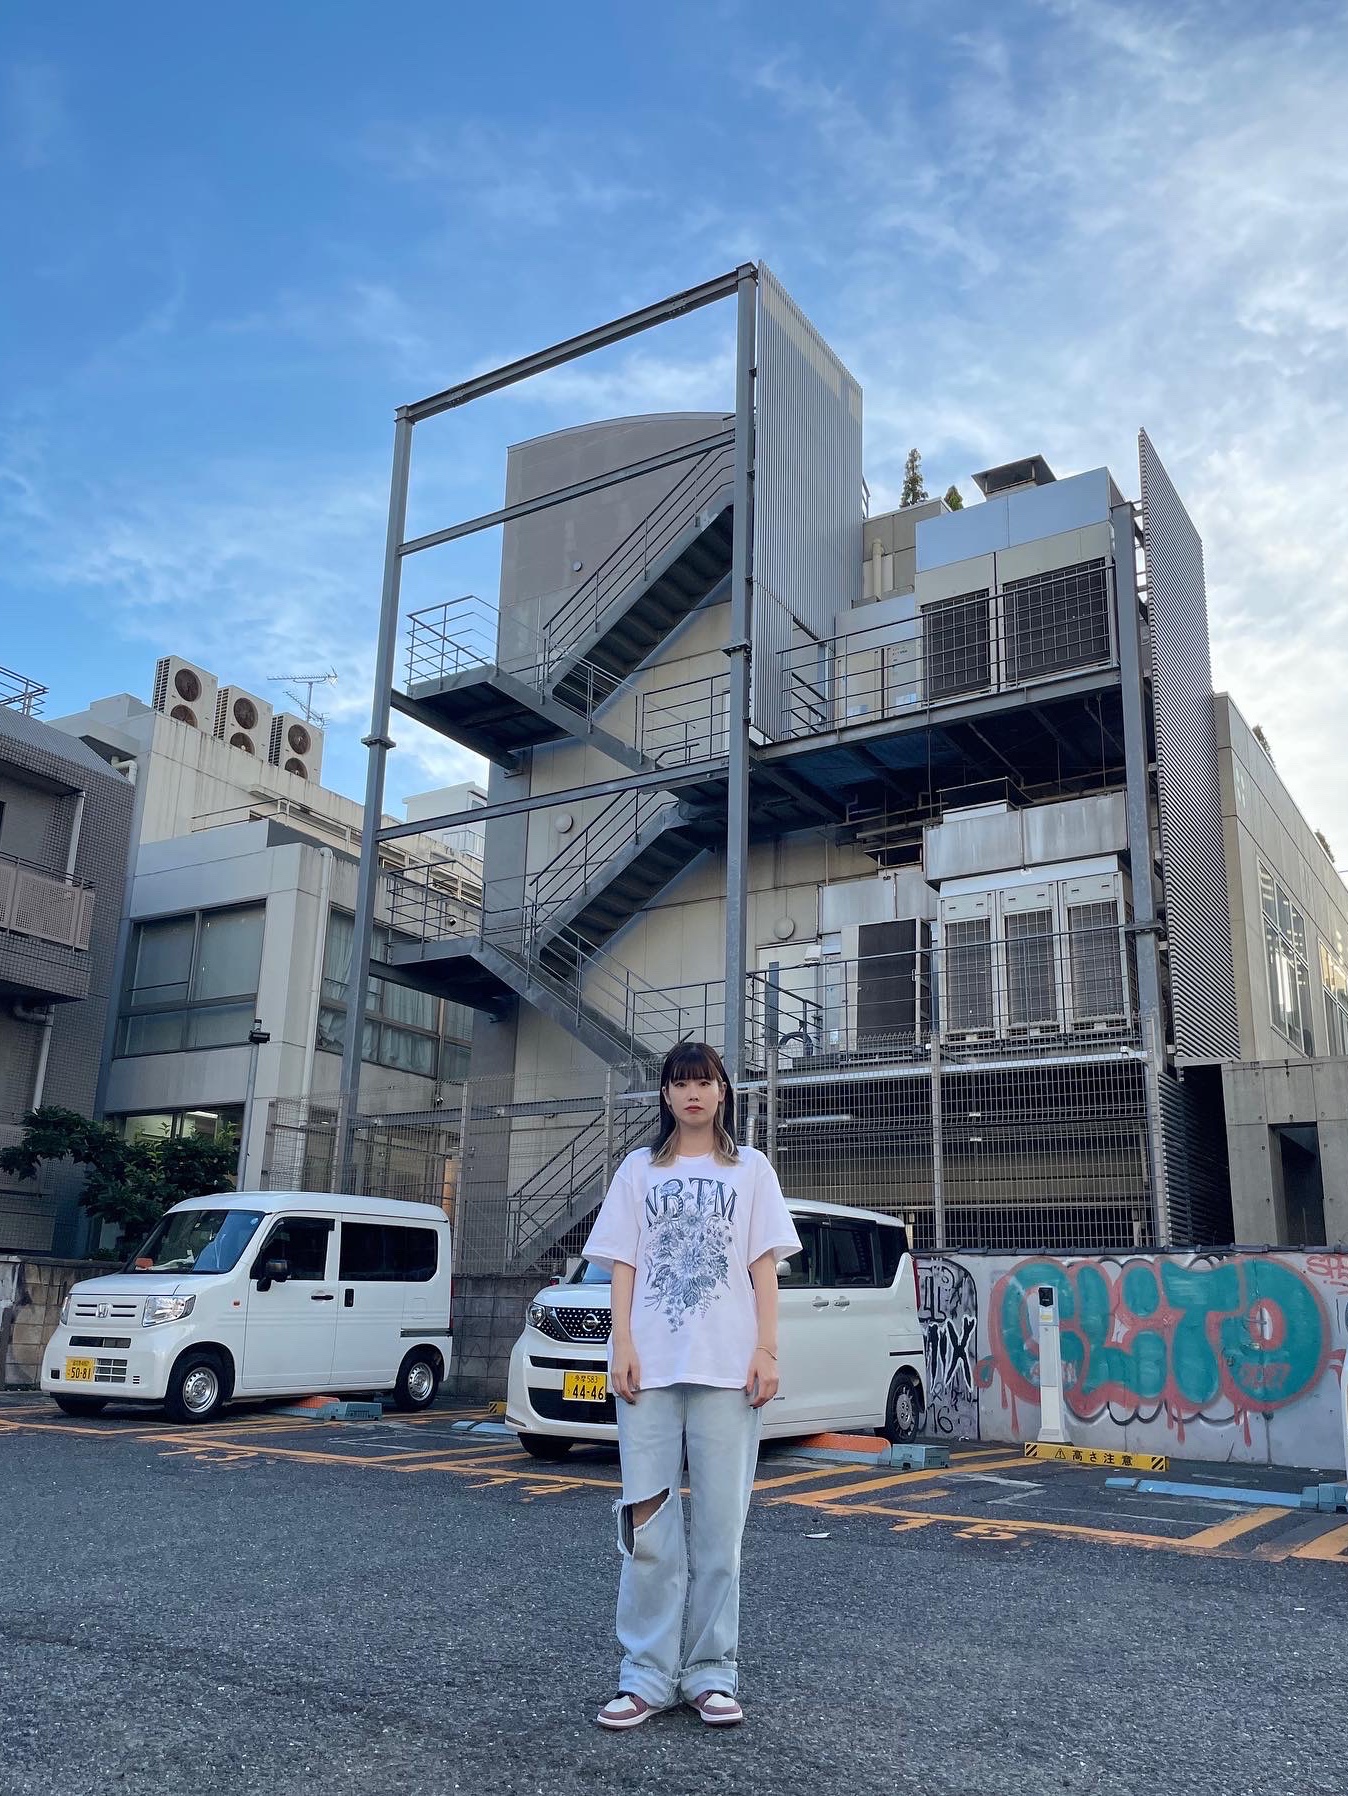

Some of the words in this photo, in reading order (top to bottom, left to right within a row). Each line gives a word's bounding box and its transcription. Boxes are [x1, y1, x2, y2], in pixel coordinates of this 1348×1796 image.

[572, 1384, 604, 1400] 44-46
[1072, 1450, 1133, 1467] 高さ注意
